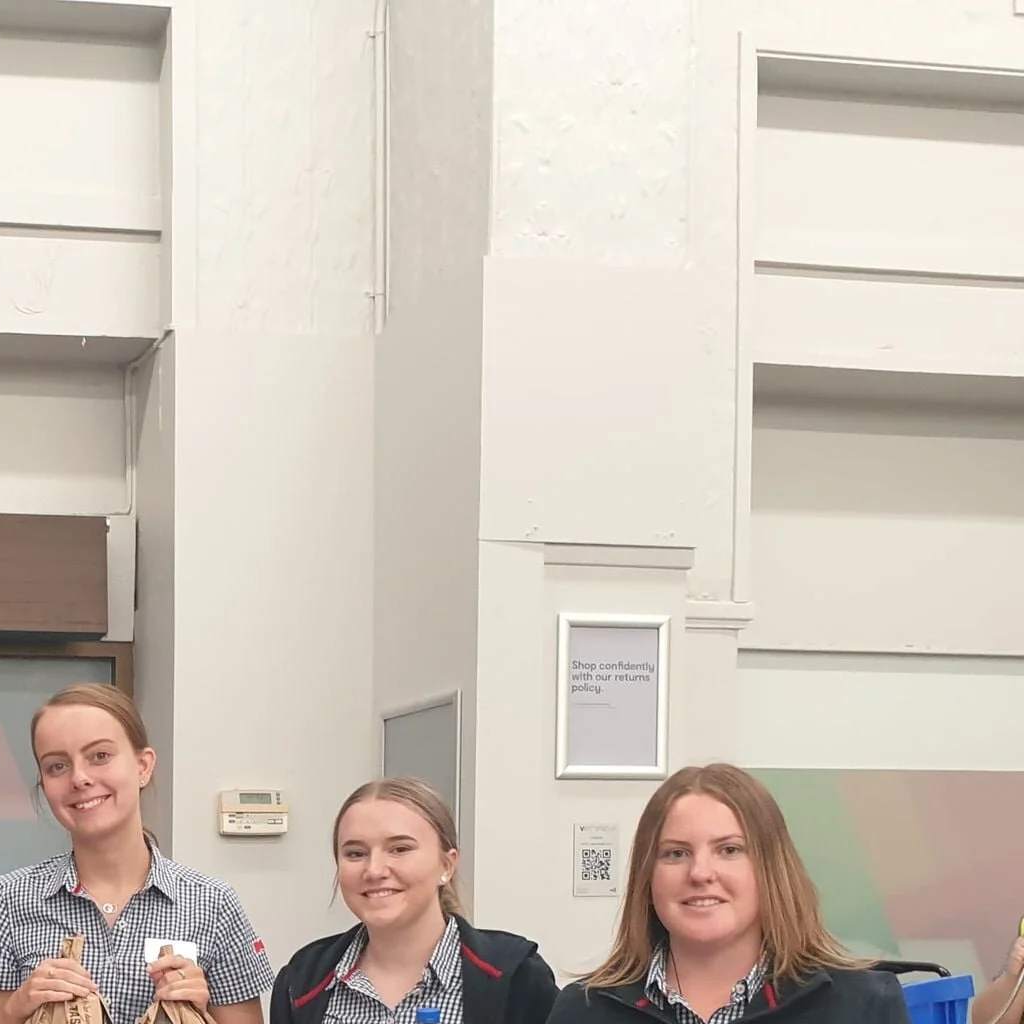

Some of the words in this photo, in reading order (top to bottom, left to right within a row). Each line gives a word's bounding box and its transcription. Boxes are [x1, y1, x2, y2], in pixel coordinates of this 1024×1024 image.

[572, 660, 597, 672] Shop
[599, 661, 655, 673] confidently
[572, 671, 593, 681] with
[595, 673, 612, 681] our
[614, 673, 650, 682] returns
[571, 683, 604, 694] policy.
